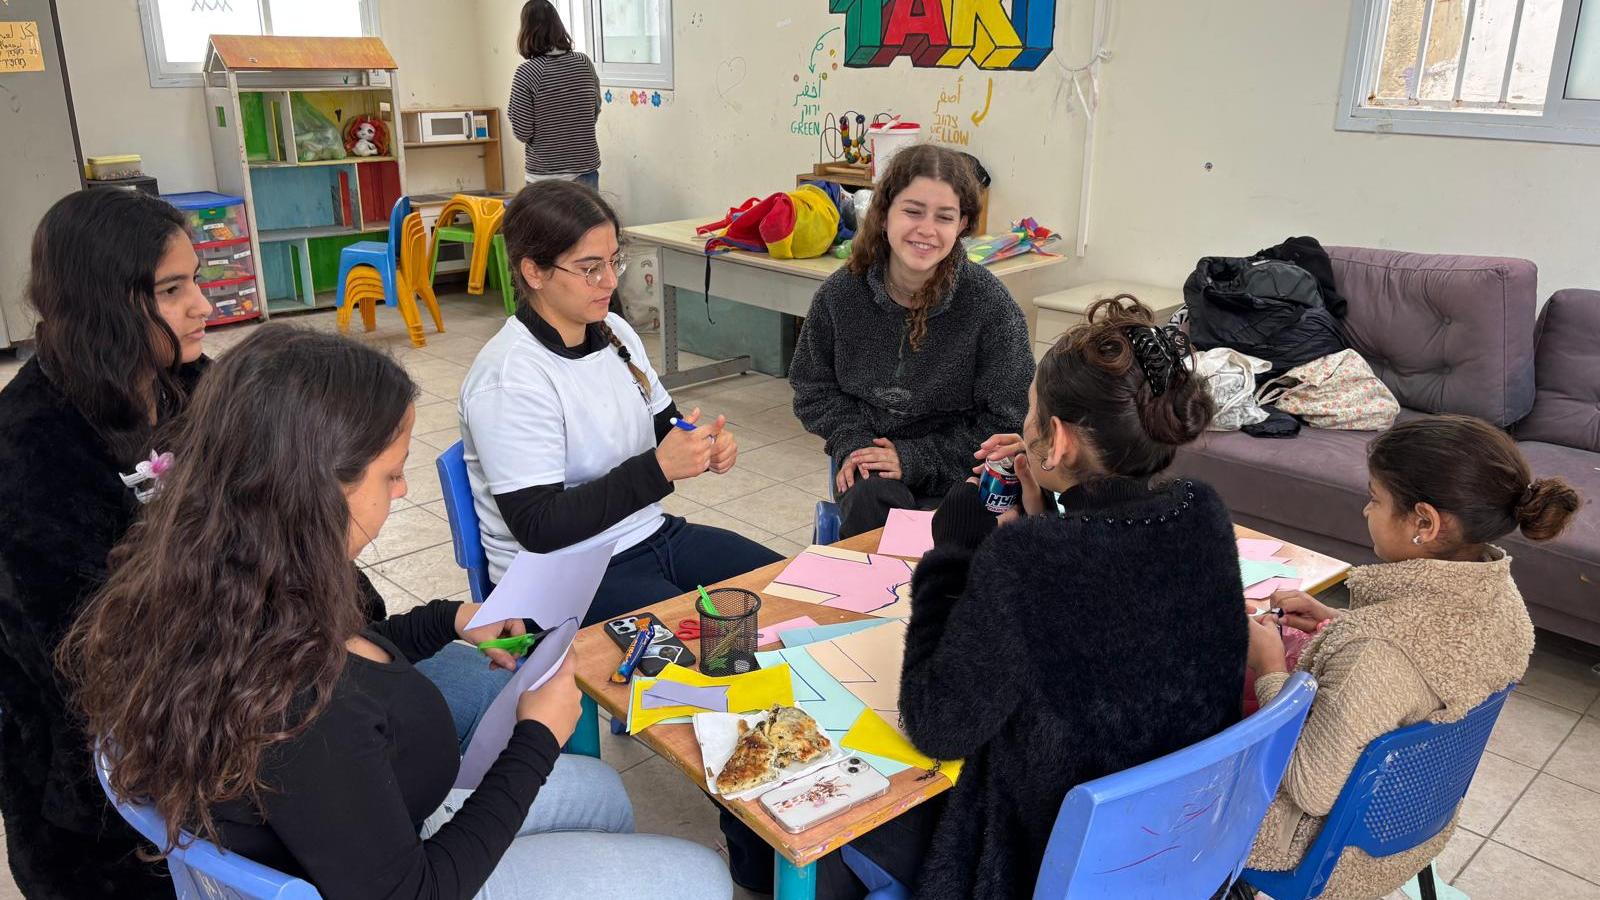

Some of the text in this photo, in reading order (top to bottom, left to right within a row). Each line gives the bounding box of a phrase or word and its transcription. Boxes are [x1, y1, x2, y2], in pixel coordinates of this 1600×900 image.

[801, 104, 820, 124] ירוק
[934, 113, 958, 128] צהוב
[791, 120, 820, 136] GREEN
[986, 492, 1016, 507] HY
